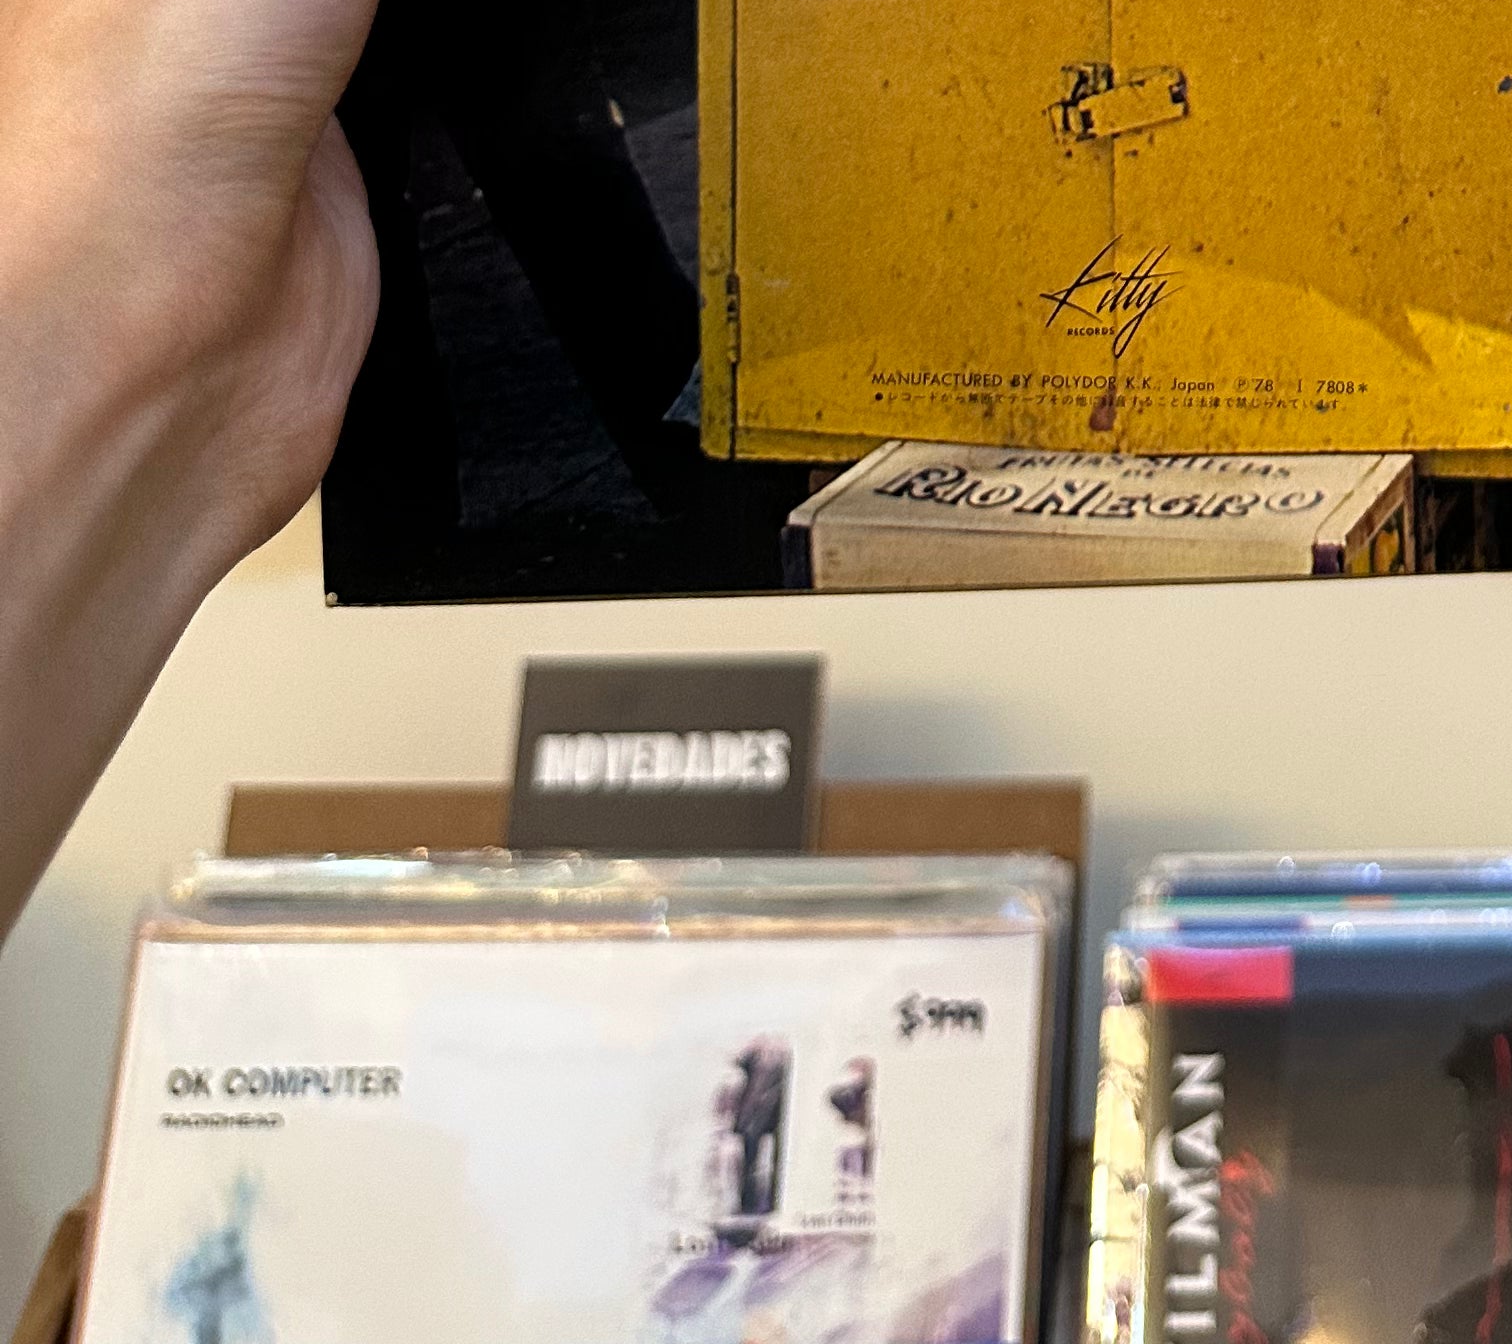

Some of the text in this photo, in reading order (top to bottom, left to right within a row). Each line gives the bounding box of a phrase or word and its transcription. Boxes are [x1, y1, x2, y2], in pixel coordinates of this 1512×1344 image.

[1039, 233, 1186, 360] Kitty
[1066, 326, 1116, 337] RECORDS
[871, 372, 1003, 388] MANUFACTURED
[1009, 373, 1033, 388] BY
[1041, 374, 1117, 390] POLYDOR
[1170, 377, 1215, 395] Japan
[1014, 477, 1326, 518] NEGRO
[533, 729, 791, 792] NOVEDADES
[166, 1065, 402, 1098] OK COMPUTER
